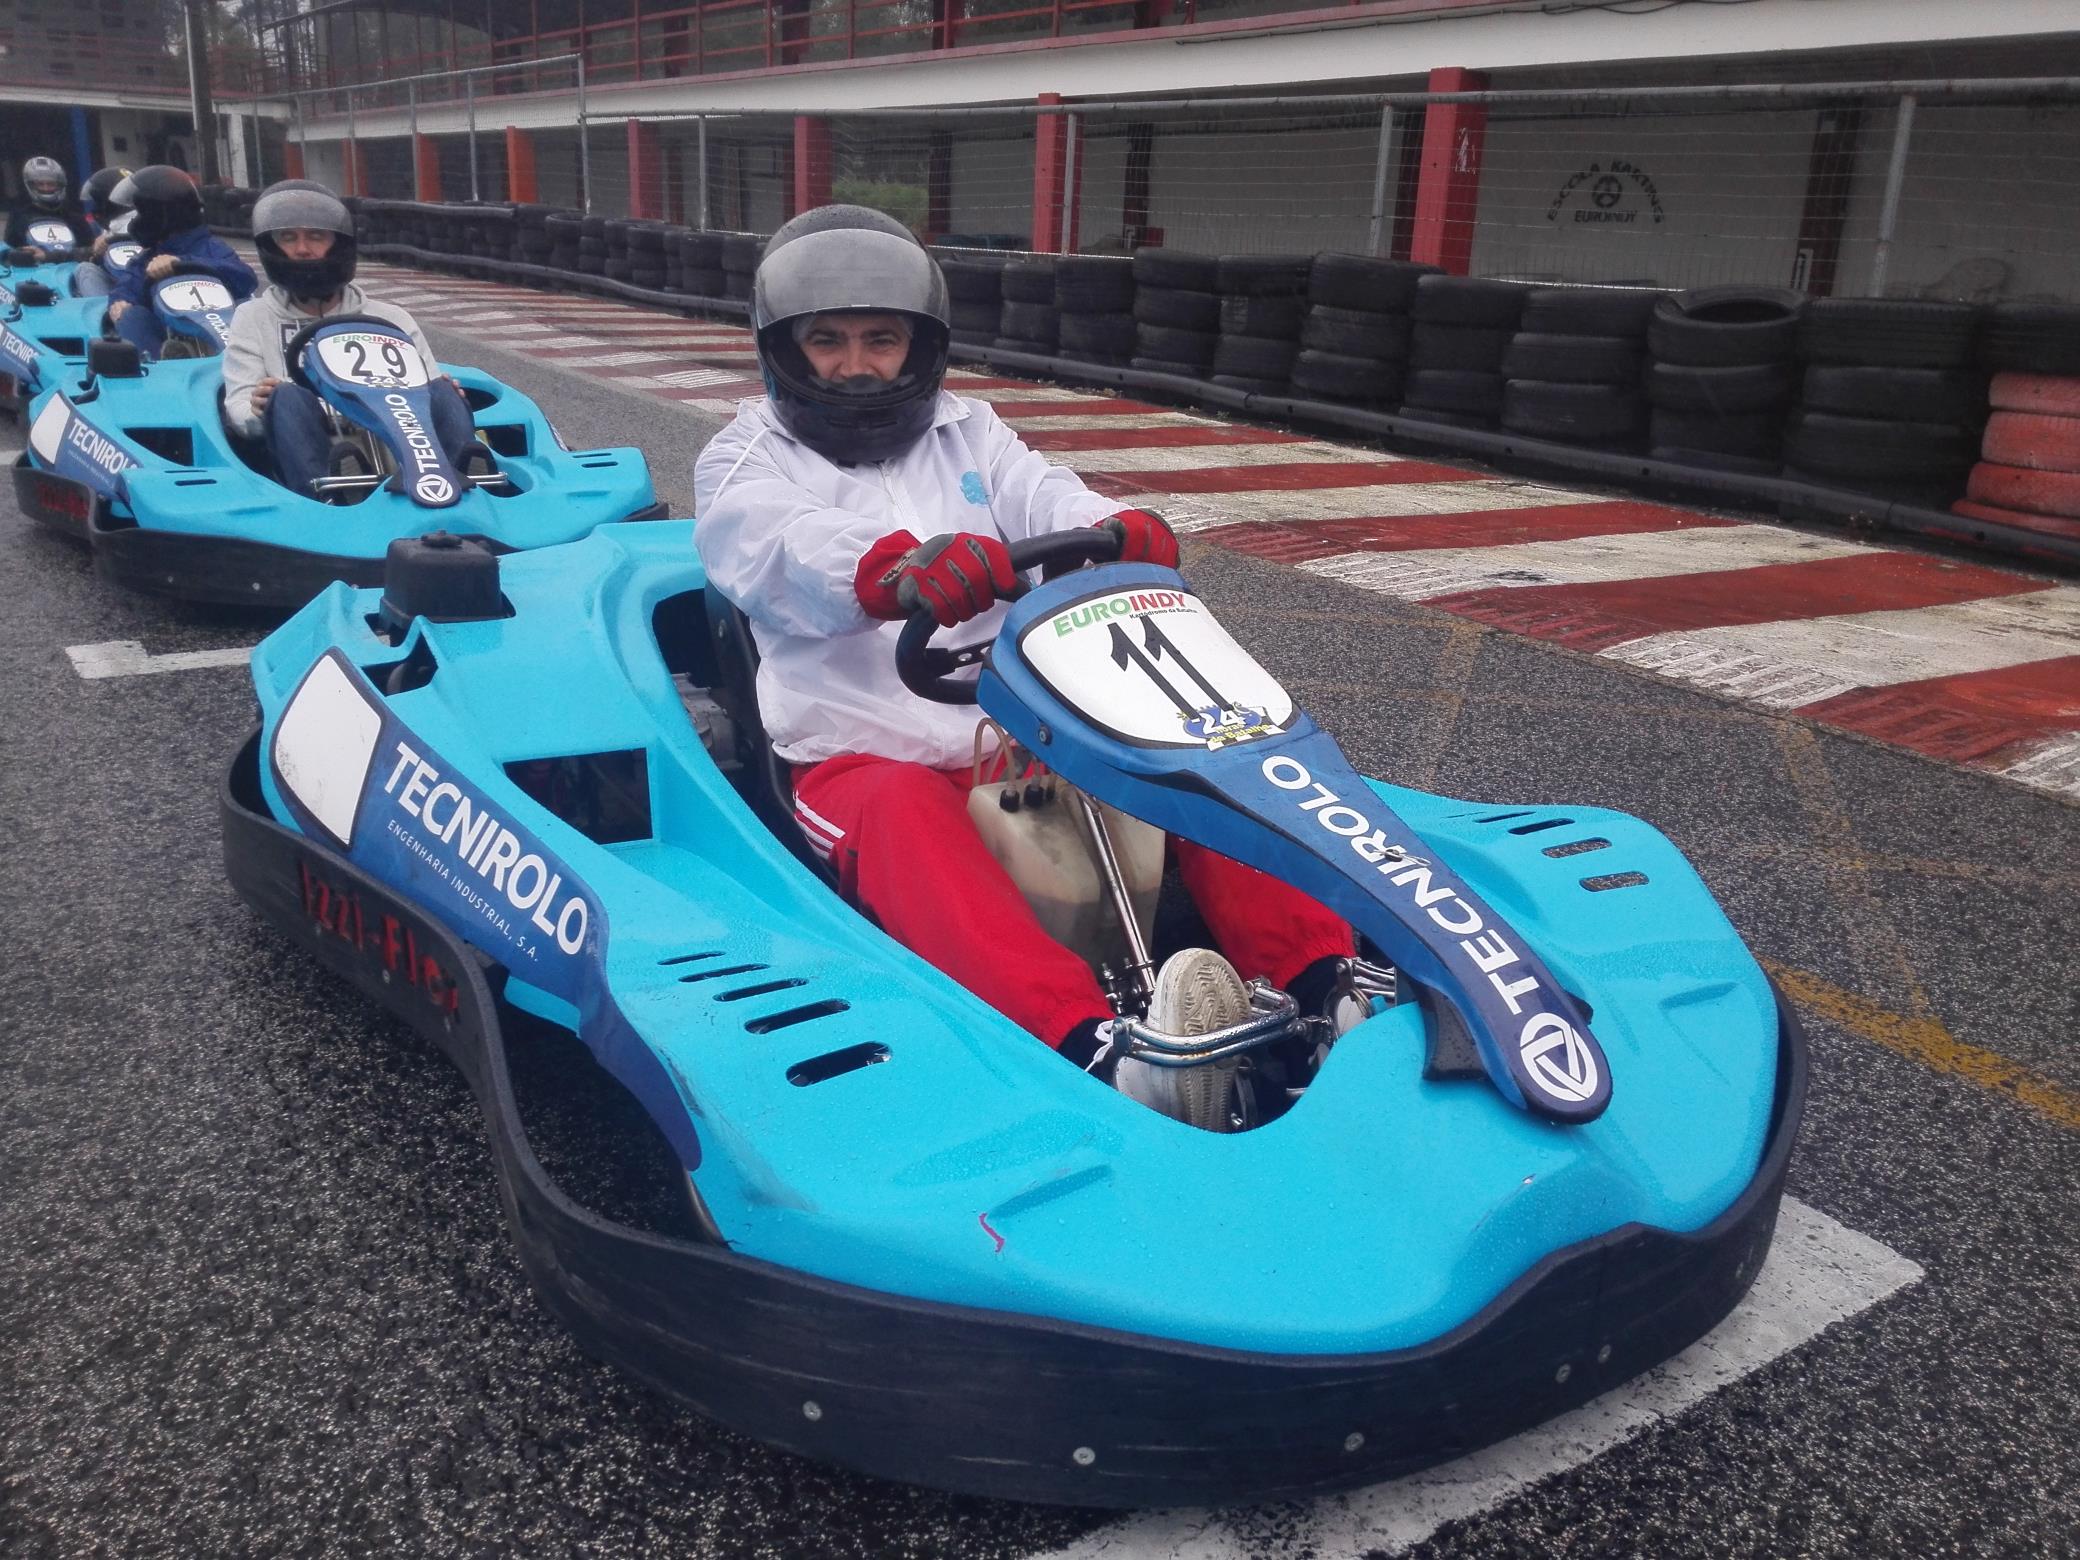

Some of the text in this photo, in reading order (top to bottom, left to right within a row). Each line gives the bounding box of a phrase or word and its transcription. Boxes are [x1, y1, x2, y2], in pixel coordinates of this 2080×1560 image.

[1547, 163, 1600, 221] ESCOLA
[1574, 210, 1638, 223] EUROINDY
[47, 227, 57, 240] 4
[189, 285, 205, 306] 1
[333, 335, 405, 348] EUROINDY
[344, 340, 407, 378] 29
[68, 418, 137, 474] TECNIROL
[385, 393, 440, 473] TECNIROLO
[1053, 592, 1186, 637] EUROINDY
[1107, 615, 1236, 719] 11
[1199, 709, 1247, 735] 24
[384, 741, 588, 955] TECNIROLO
[387, 819, 539, 962] ENGENHARIA INDUSTRIAL, S.A.
[1261, 755, 1540, 1016] TECNIROLO
